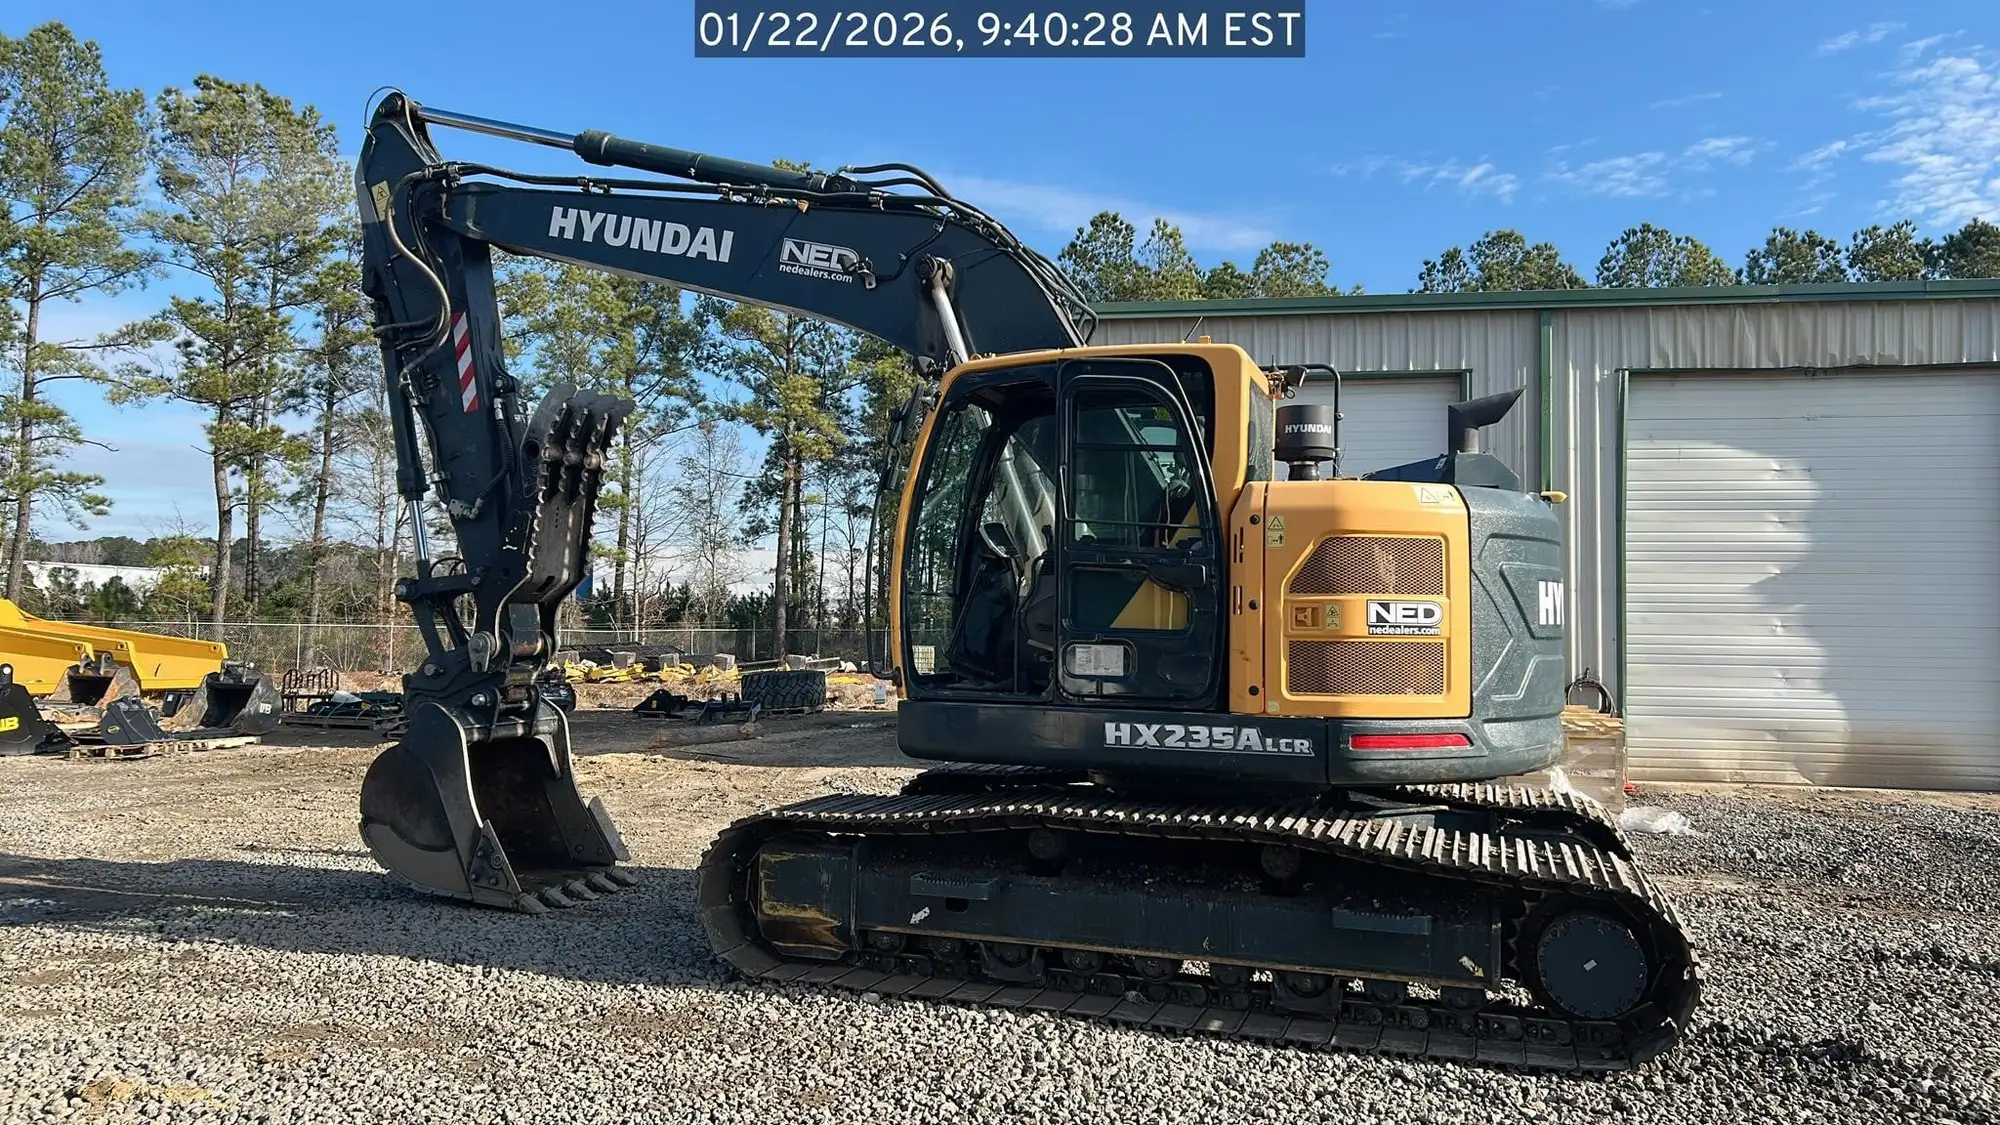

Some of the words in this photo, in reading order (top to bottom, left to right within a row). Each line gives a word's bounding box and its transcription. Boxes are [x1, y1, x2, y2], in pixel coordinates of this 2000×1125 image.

[548, 206, 734, 263] HYUNDAI
[781, 240, 858, 270] NED
[779, 264, 853, 284] nedealers.com
[1284, 423, 1332, 434] HYUNDAI
[1369, 602, 1442, 624] NED
[1538, 580, 1565, 626] HY
[1369, 626, 1441, 635] nedealers.com
